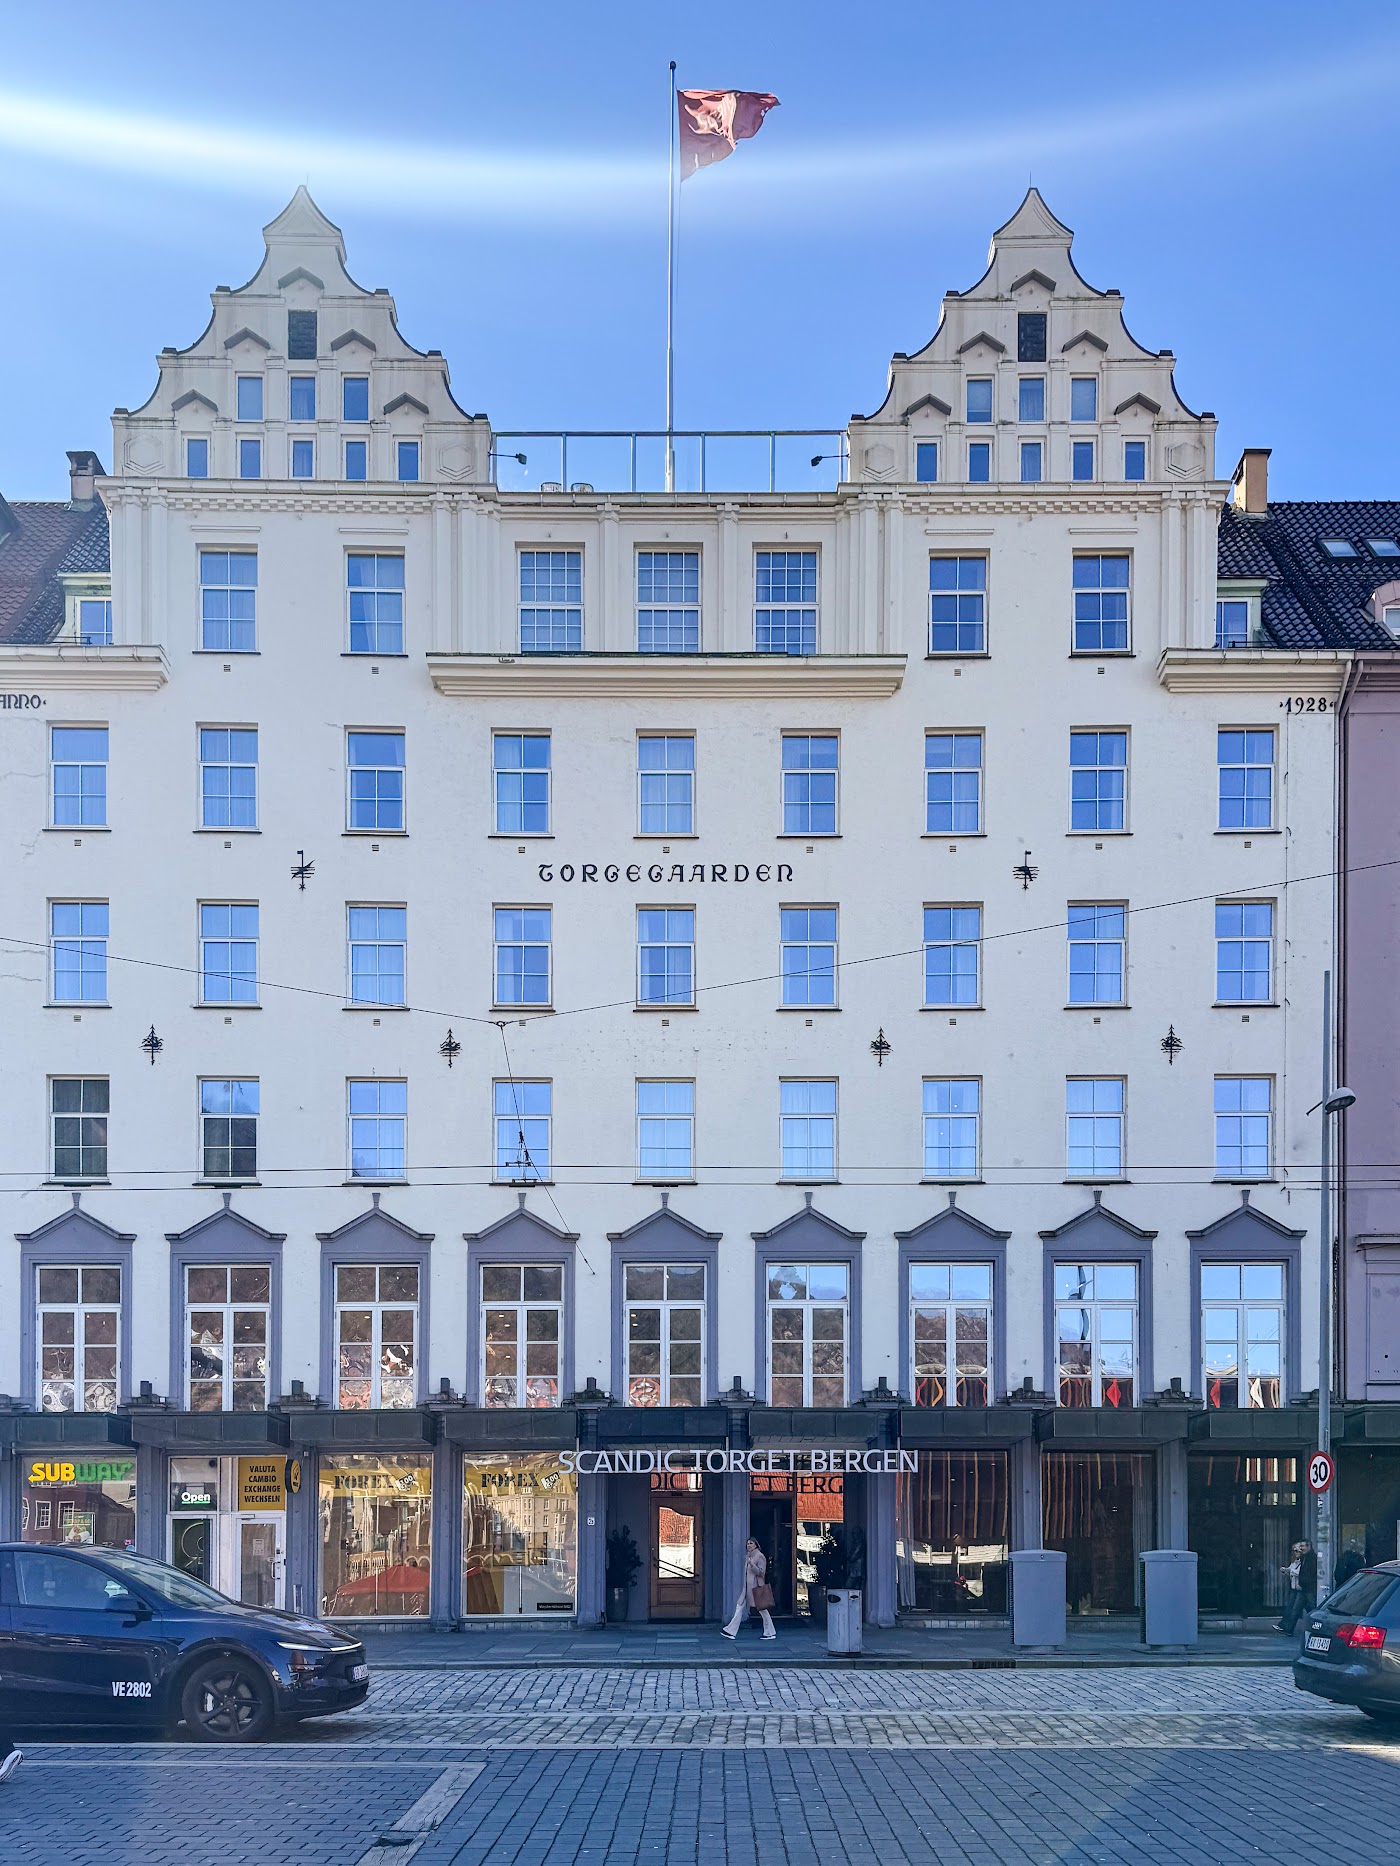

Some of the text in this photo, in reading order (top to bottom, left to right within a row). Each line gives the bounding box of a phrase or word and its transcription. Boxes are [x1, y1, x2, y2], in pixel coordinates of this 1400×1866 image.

[537, 863, 794, 883] TORGEGAARDEN
[558, 1449, 919, 1474] SCANDIC TORGET BERGEN
[28, 1462, 132, 1482] SUBWAY
[249, 1465, 276, 1473] VALUTA
[1312, 1461, 1328, 1483] 30
[248, 1475, 277, 1483] CAMBIO
[333, 1475, 394, 1489] FOREX
[481, 1473, 540, 1487] FOREX
[244, 1485, 281, 1493] EXCHANGE
[181, 1492, 211, 1504] Open
[244, 1495, 281, 1503] WECHSELN
